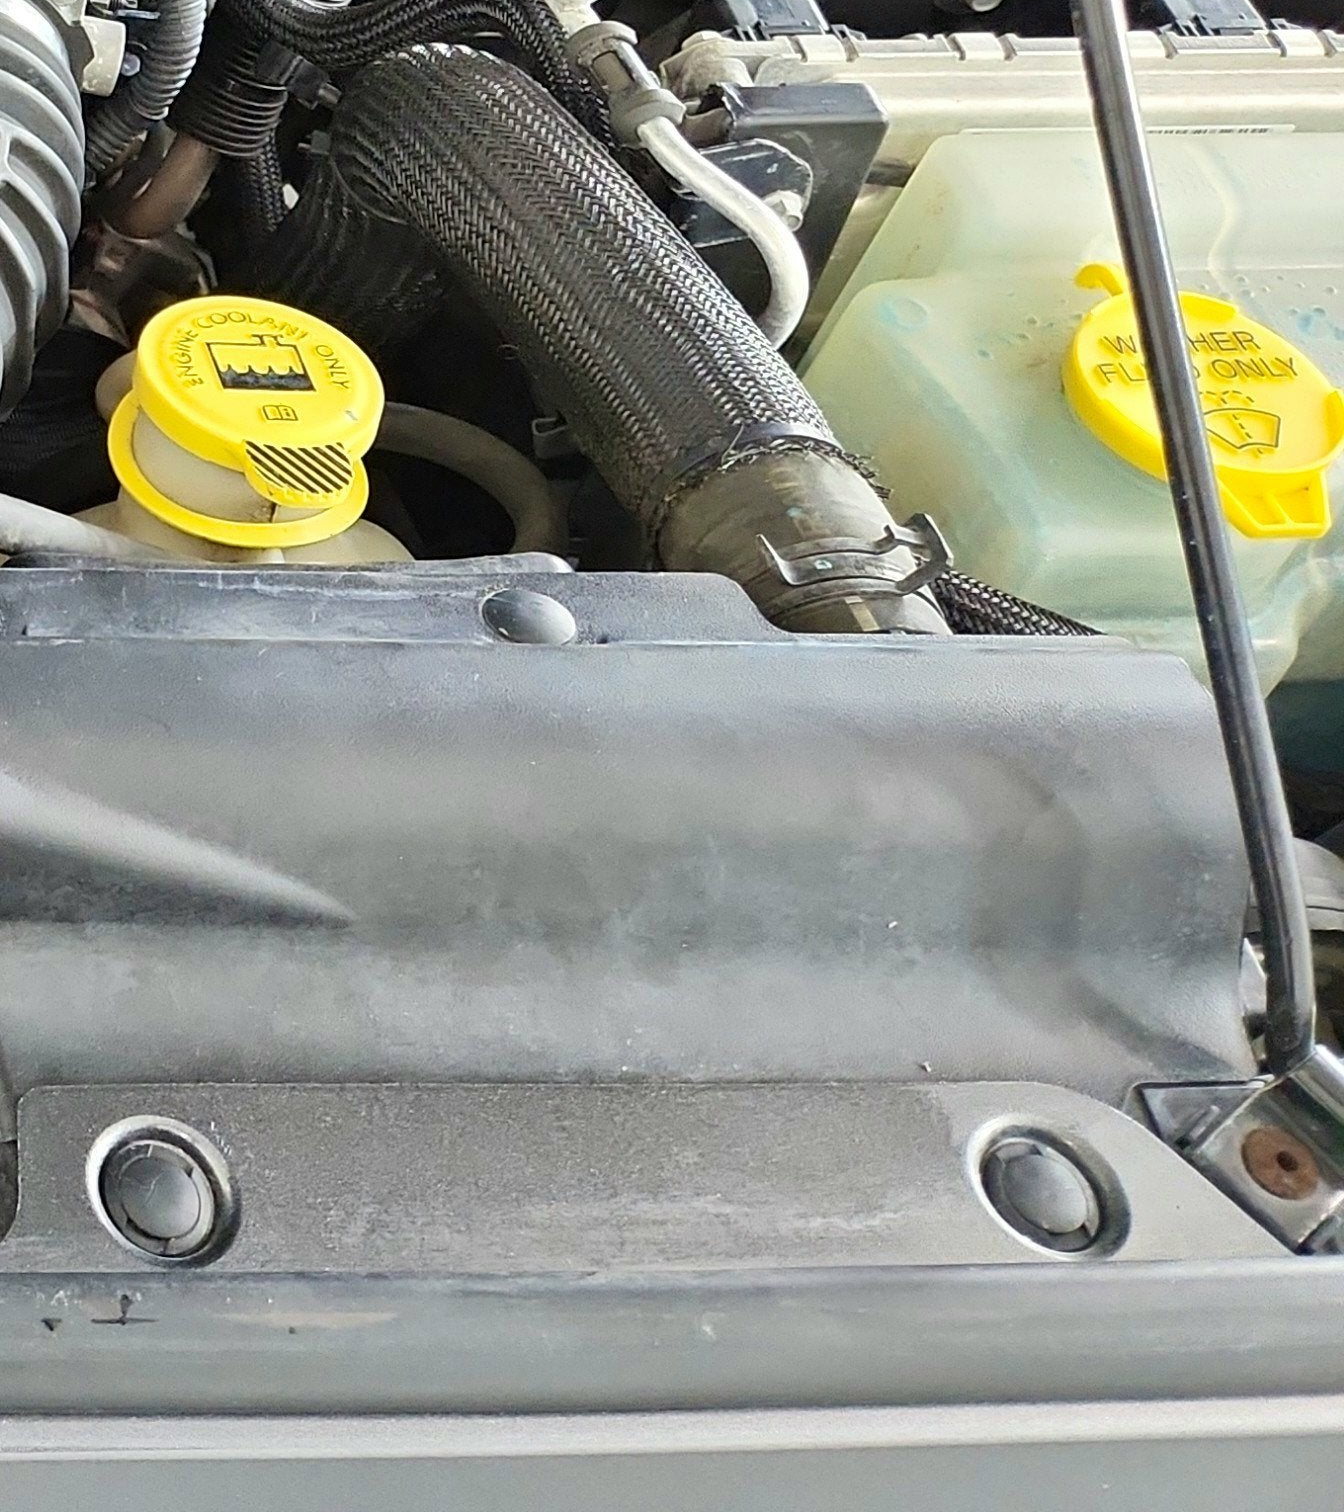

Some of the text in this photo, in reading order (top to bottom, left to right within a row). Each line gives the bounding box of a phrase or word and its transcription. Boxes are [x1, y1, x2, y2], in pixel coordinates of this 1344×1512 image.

[176, 311, 350, 388] ENGINE COOLANT ONLY
[1103, 331, 1261, 354] WHER
[1211, 357, 1298, 379] ONLY
